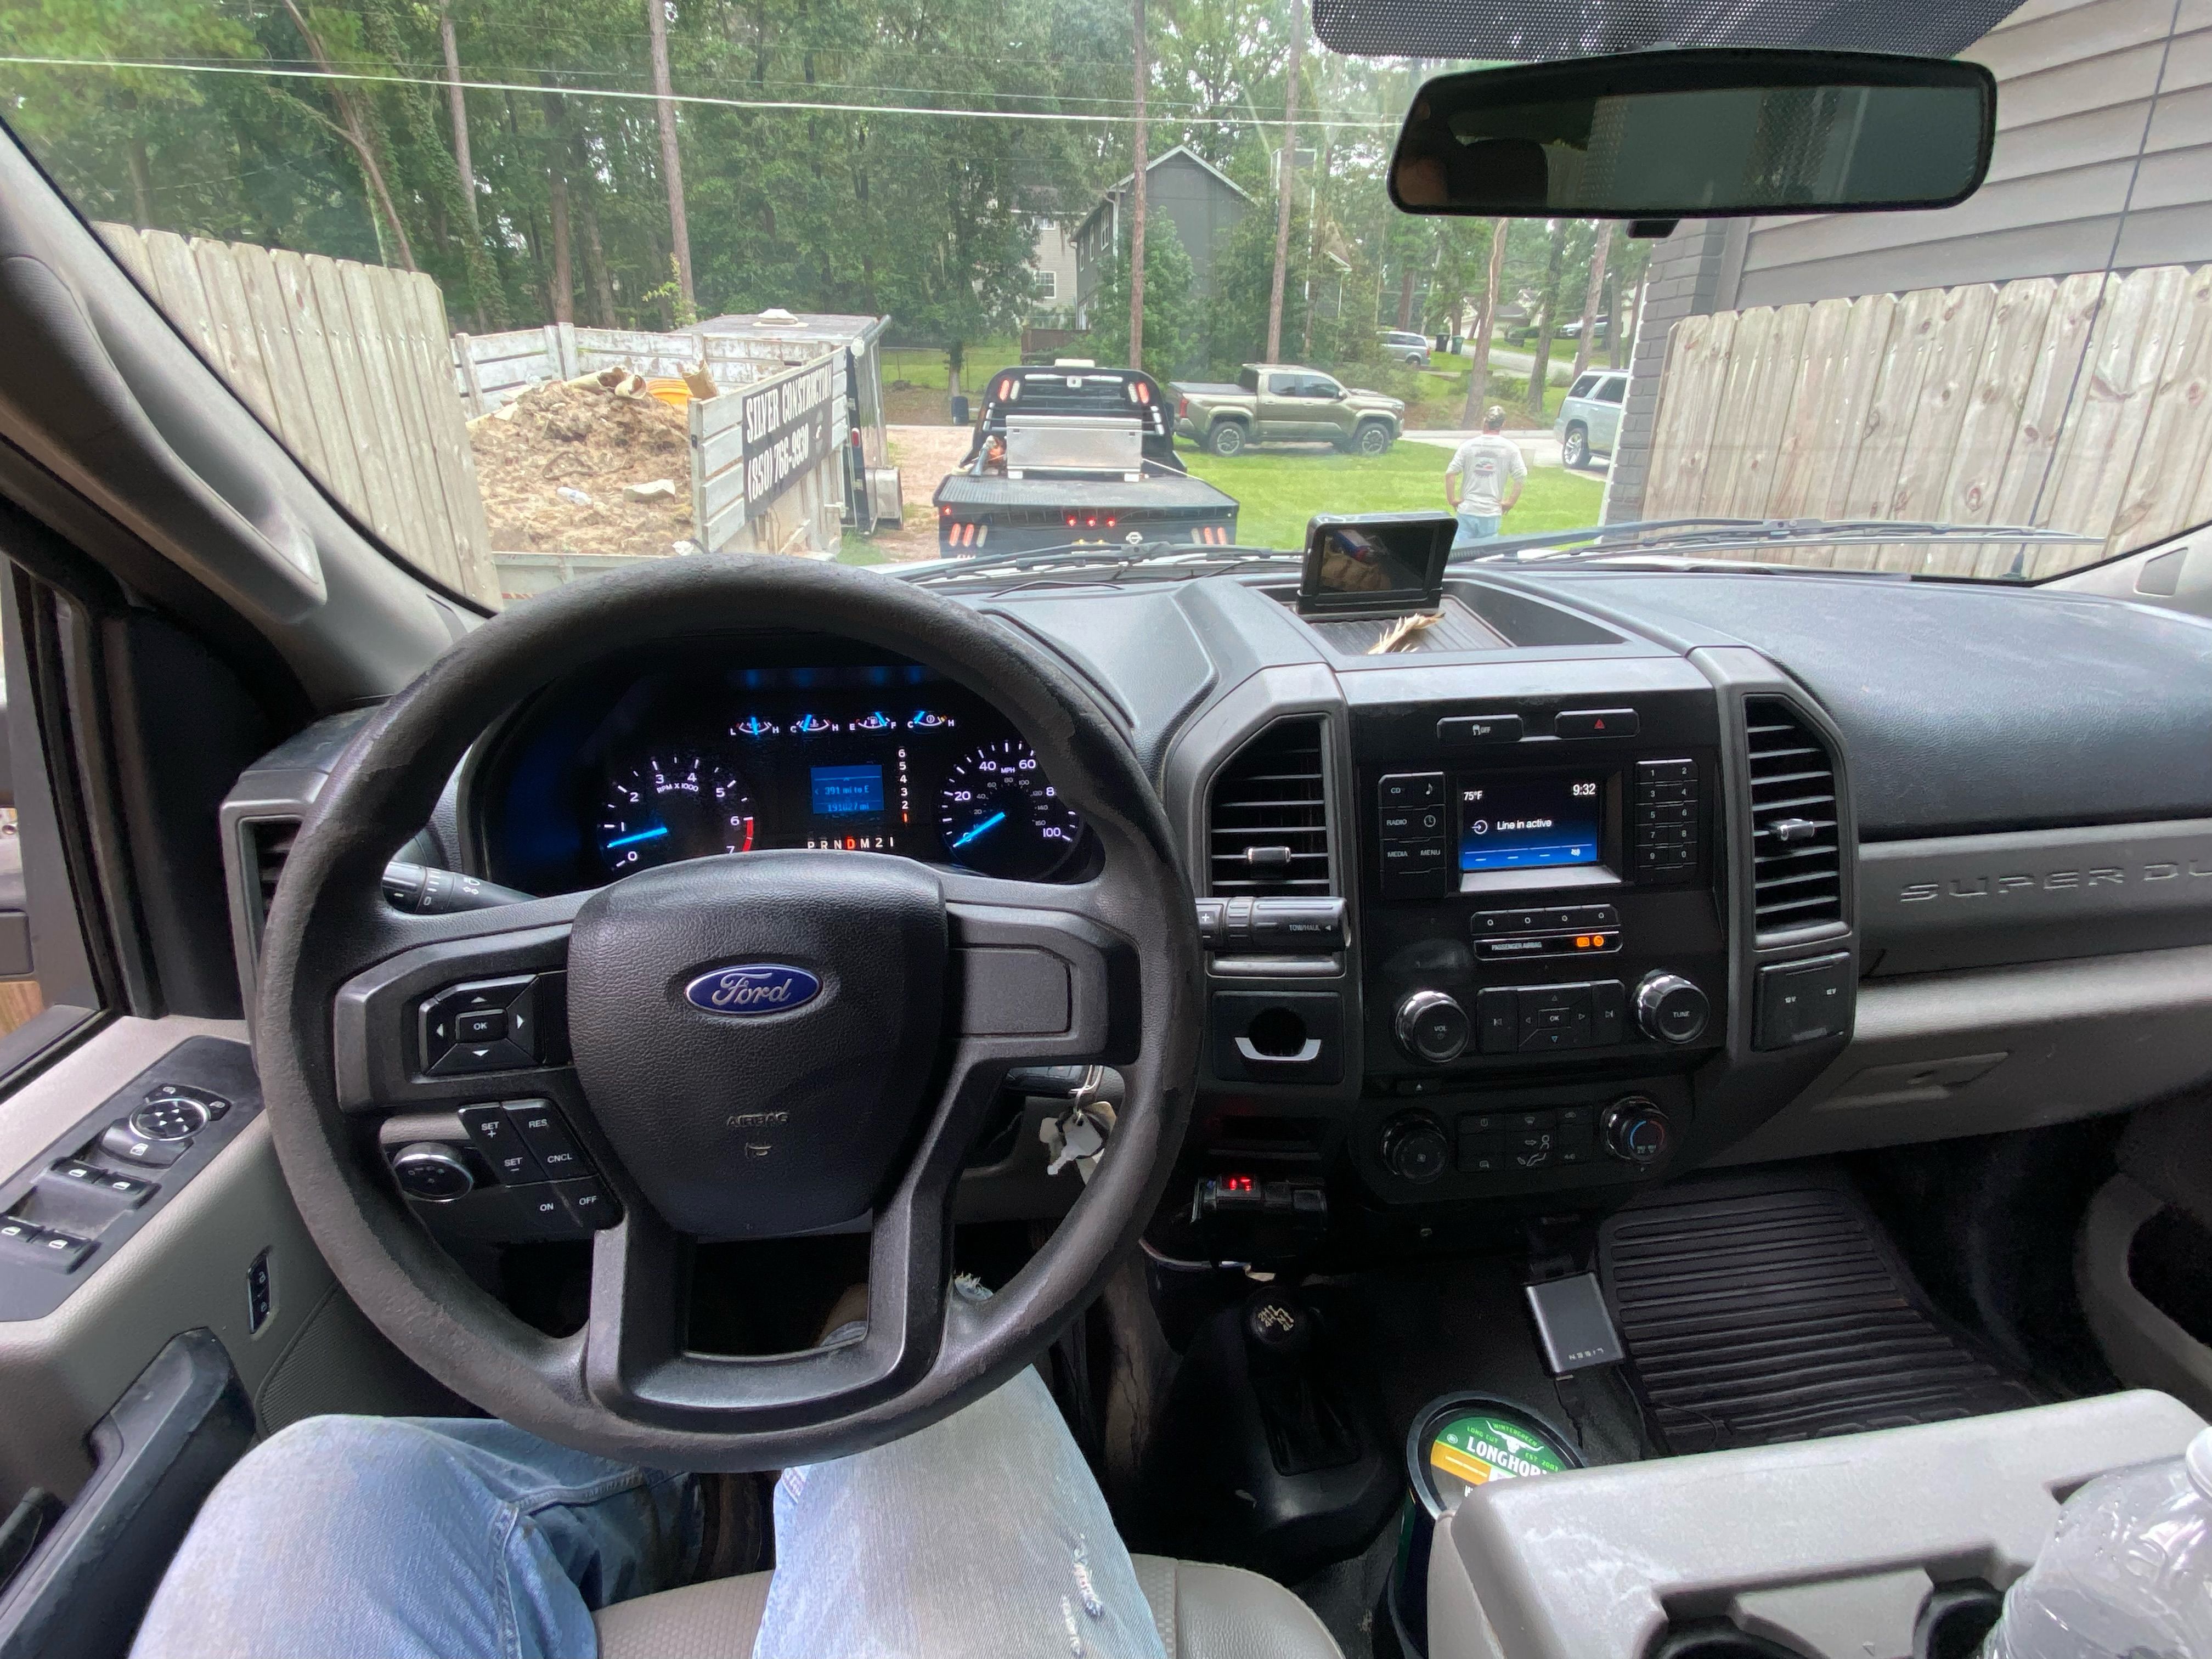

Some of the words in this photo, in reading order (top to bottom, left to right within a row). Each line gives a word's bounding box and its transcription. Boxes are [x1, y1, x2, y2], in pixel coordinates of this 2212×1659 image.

[747, 388, 779, 443] SILVER
[782, 363, 832, 424] CONSTRUCTION
[748, 447, 772, 503] (850)
[774, 423, 809, 483] 766-9930
[979, 761, 996, 771] 40
[1019, 759, 1036, 769] 60
[655, 774, 664, 784] 3
[687, 772, 697, 782] 4
[900, 775, 907, 783] 4
[657, 784, 672, 793] RPM
[681, 783, 699, 792] 1000
[716, 787, 725, 797] 5
[864, 785, 869, 793] E
[901, 788, 907, 796] 3
[1046, 787, 1056, 796] 8
[1573, 783, 1596, 795] 9:32
[630, 792, 639, 802] 2
[955, 791, 971, 801] 20
[902, 801, 908, 809] 2
[730, 816, 740, 826] 6
[1497, 821, 1515, 830] Line
[1517, 820, 1524, 828] in
[1526, 819, 1552, 828] active
[1043, 827, 1061, 837] 100
[808, 841, 814, 850] P
[821, 840, 828, 850] R
[834, 840, 842, 850] N
[847, 838, 855, 850] D
[861, 839, 870, 849] M
[876, 838, 883, 848] 2
[628, 851, 637, 861] 0
[1900, 866, 2125, 904] SUPER
[712, 972, 793, 1006] Ford
[1672, 1011, 1690, 1019] TUNE
[473, 1022, 487, 1030] OK
[481, 1121, 499, 1131] SET
[529, 1119, 548, 1128] RES
[504, 1157, 523, 1166] SET
[548, 1153, 572, 1164] CNCL
[579, 1196, 597, 1205] OFF
[540, 1203, 554, 1211] ON
[1467, 1426, 1483, 1437] LONG
[1485, 1434, 1499, 1444] CUT
[1466, 1436, 1548, 1477] LONGHOR
